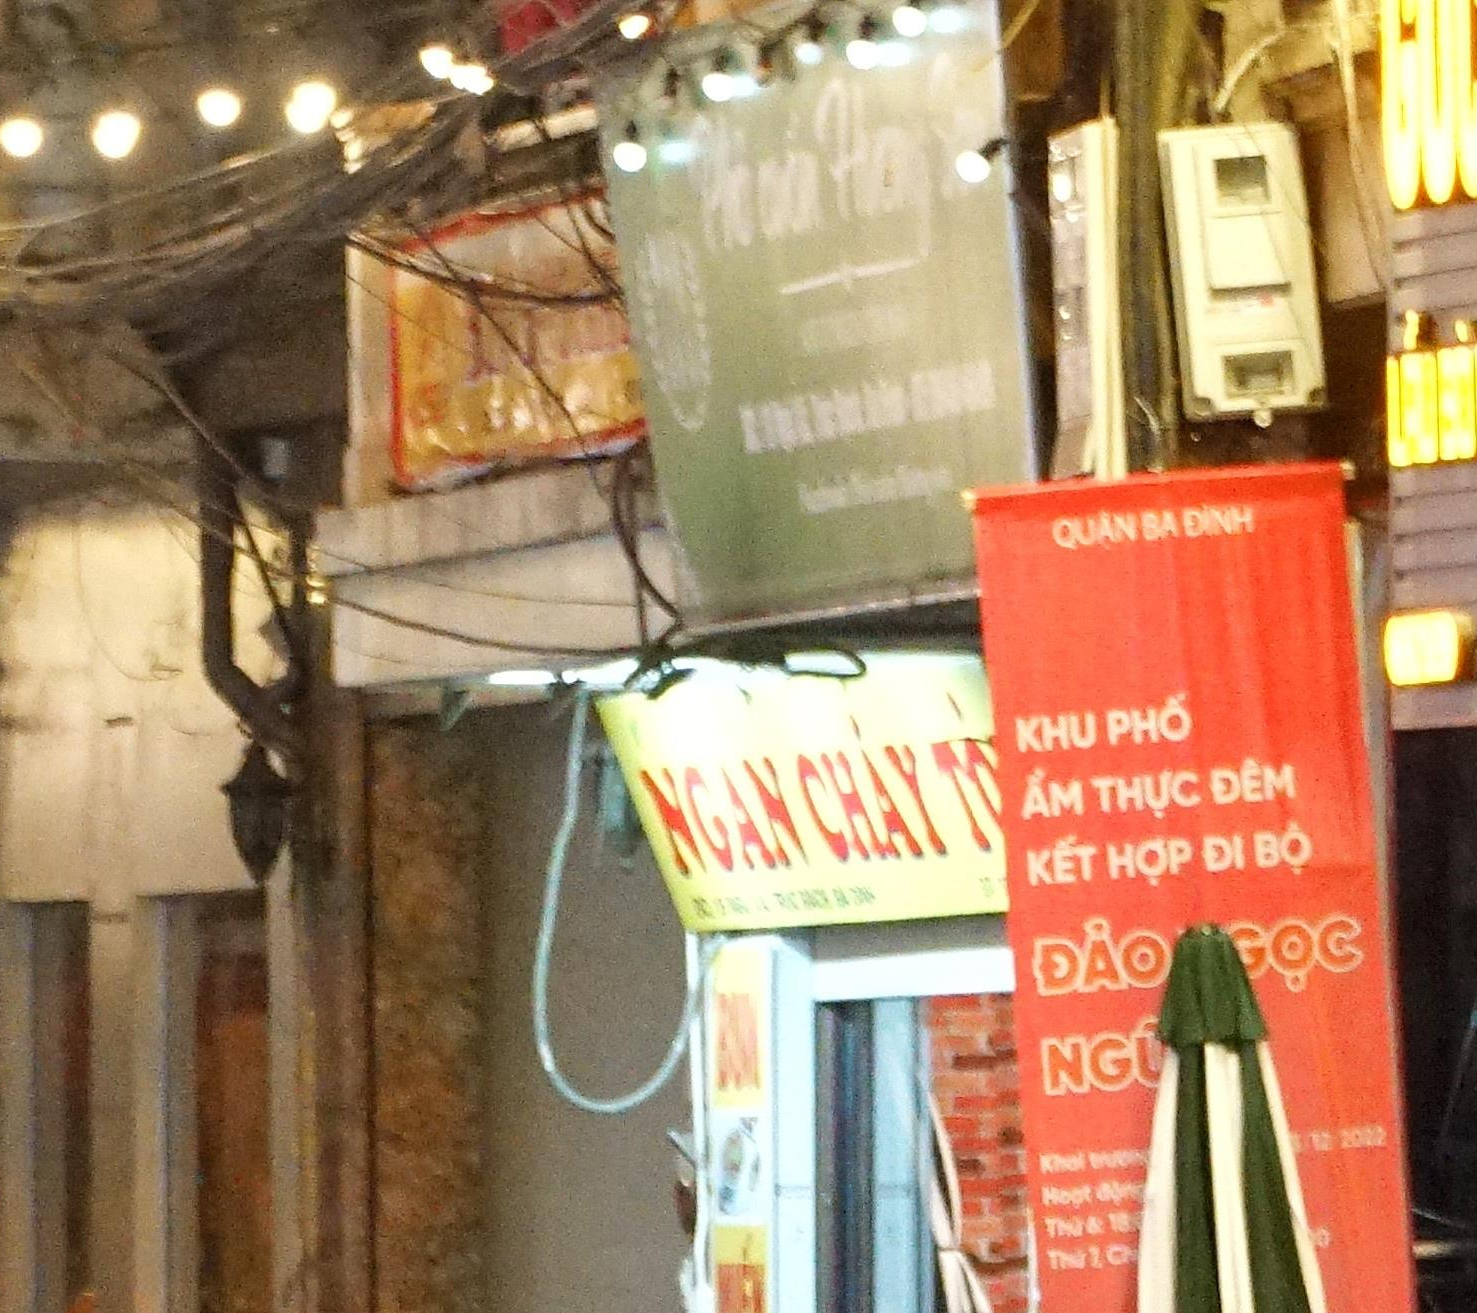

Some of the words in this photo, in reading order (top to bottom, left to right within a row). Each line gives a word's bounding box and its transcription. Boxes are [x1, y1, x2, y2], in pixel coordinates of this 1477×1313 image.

[1052, 508, 1138, 549] QUẬN
[1141, 507, 1179, 540] BA
[1182, 502, 1254, 538] ĐÌNH
[1015, 712, 1096, 752] KHU
[1106, 692, 1192, 746] PHỐ
[641, 756, 809, 877] NGAN
[1022, 766, 1084, 820] ẨM
[1091, 769, 1202, 819] THỰC
[1209, 756, 1296, 804] ĐÊM
[1026, 834, 1097, 886] KẾT
[1106, 837, 1193, 886] HỢP
[1202, 834, 1245, 872] ĐI
[1252, 819, 1312, 875] BỘ
[1032, 917, 1174, 997] ĐẢO
[1227, 913, 1364, 994] GỌC
